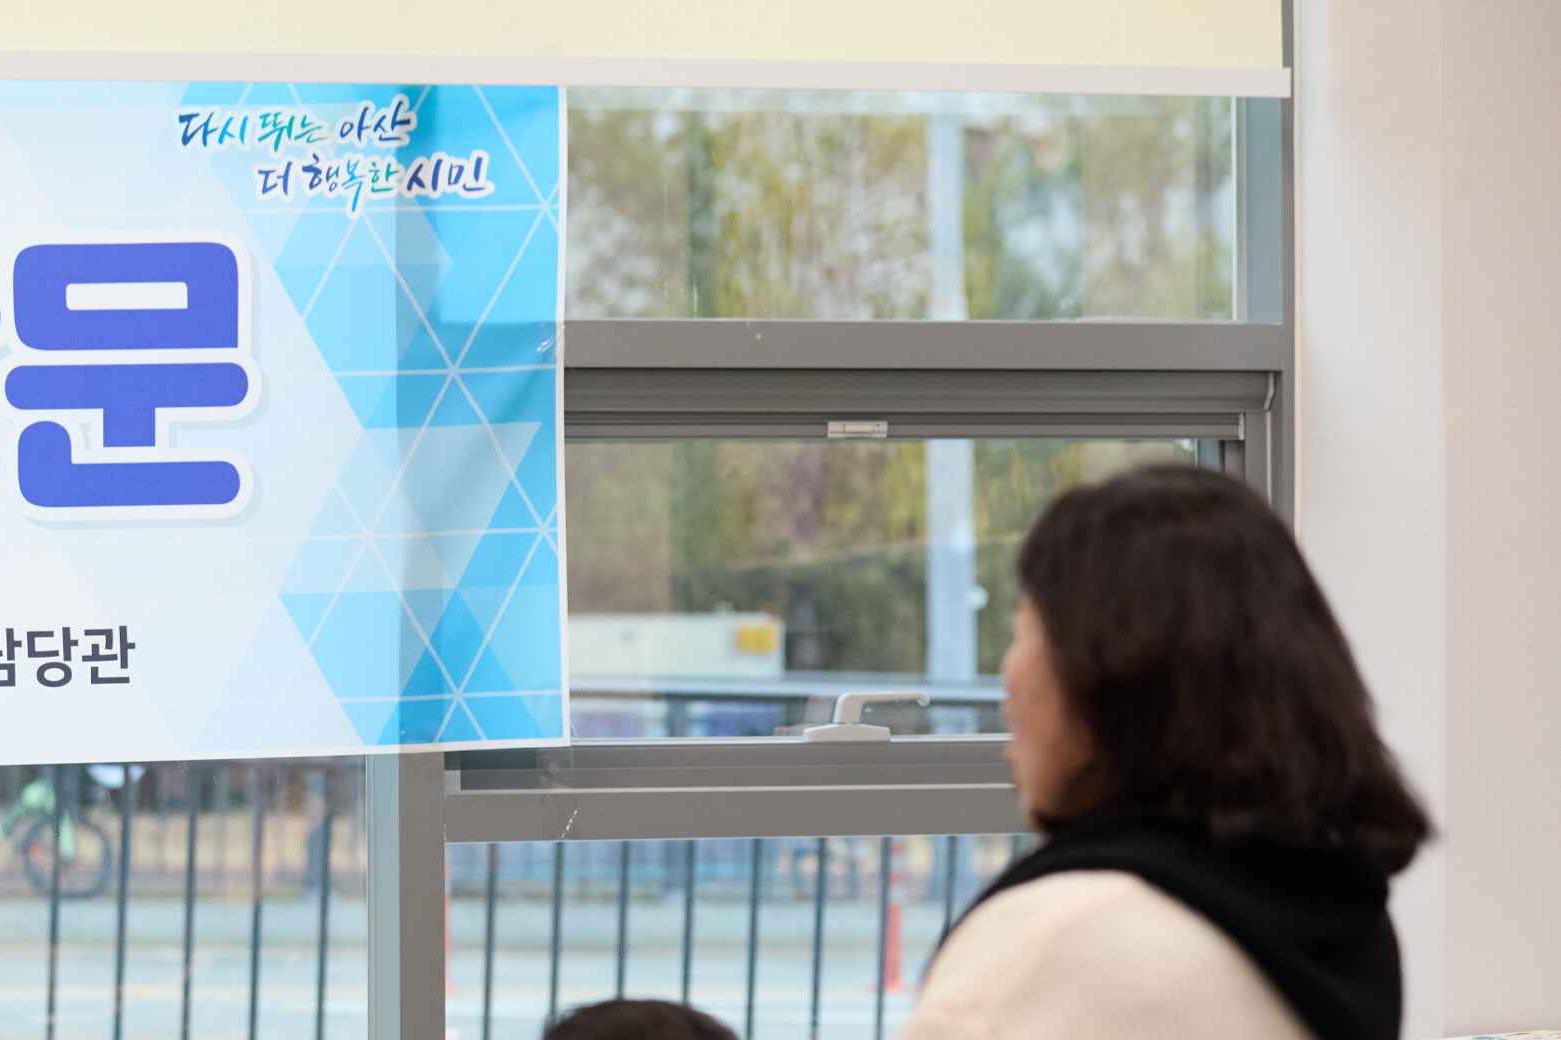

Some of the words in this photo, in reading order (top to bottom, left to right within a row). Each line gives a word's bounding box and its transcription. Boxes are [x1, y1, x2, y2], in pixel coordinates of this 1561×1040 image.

[177, 112, 247, 148] 다시
[257, 112, 328, 152] 뛰는
[339, 99, 412, 144] 아산
[257, 162, 291, 195] 더
[302, 155, 401, 213] 행복한
[406, 155, 491, 193] 시민
